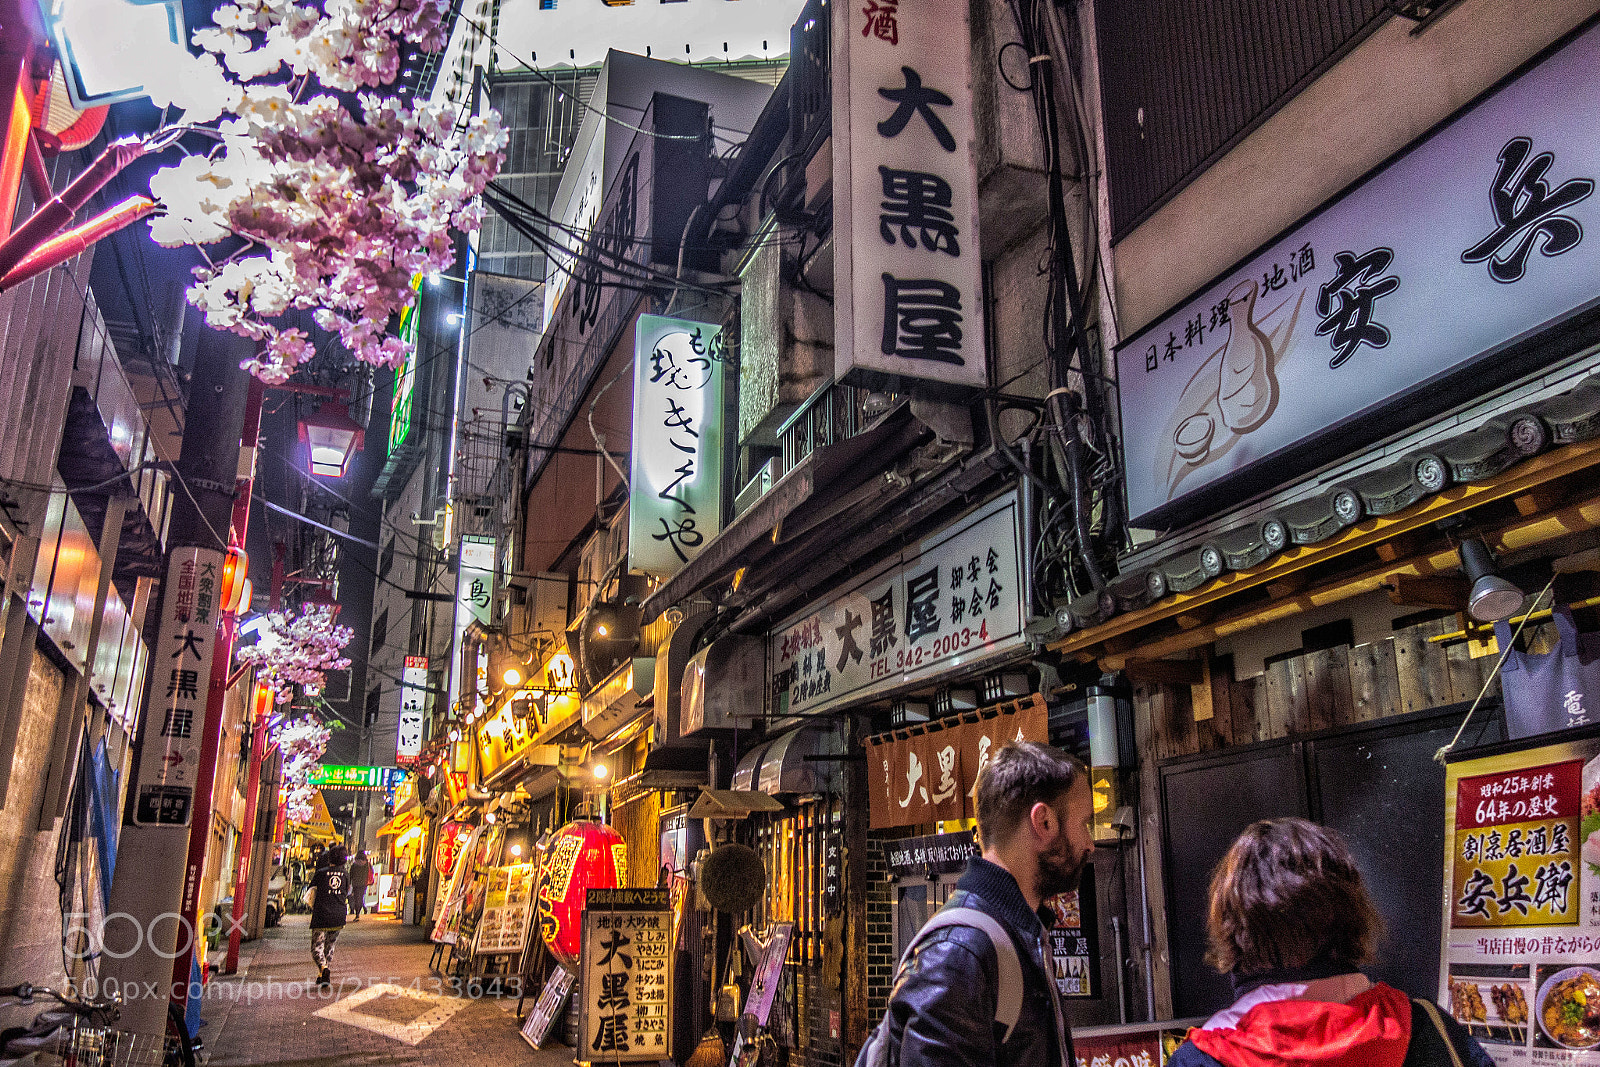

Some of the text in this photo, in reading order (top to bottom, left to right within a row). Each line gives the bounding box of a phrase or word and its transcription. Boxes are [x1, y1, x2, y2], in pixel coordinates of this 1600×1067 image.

[876, 65, 966, 367] 大黒屋
[835, 564, 941, 674] 大黒屋
[160, 630, 204, 738] 大黒屋
[869, 657, 891, 679] TEL
[1480, 773, 1555, 798] 昭和25年創業
[1475, 795, 1559, 823] 64年の歴史
[1461, 823, 1570, 864] 割烹居酒屋
[1457, 861, 1573, 919] 安兵衛
[635, 931, 666, 942] さしみ
[636, 944, 666, 956] やきとり
[592, 930, 633, 1052] 大黒屋
